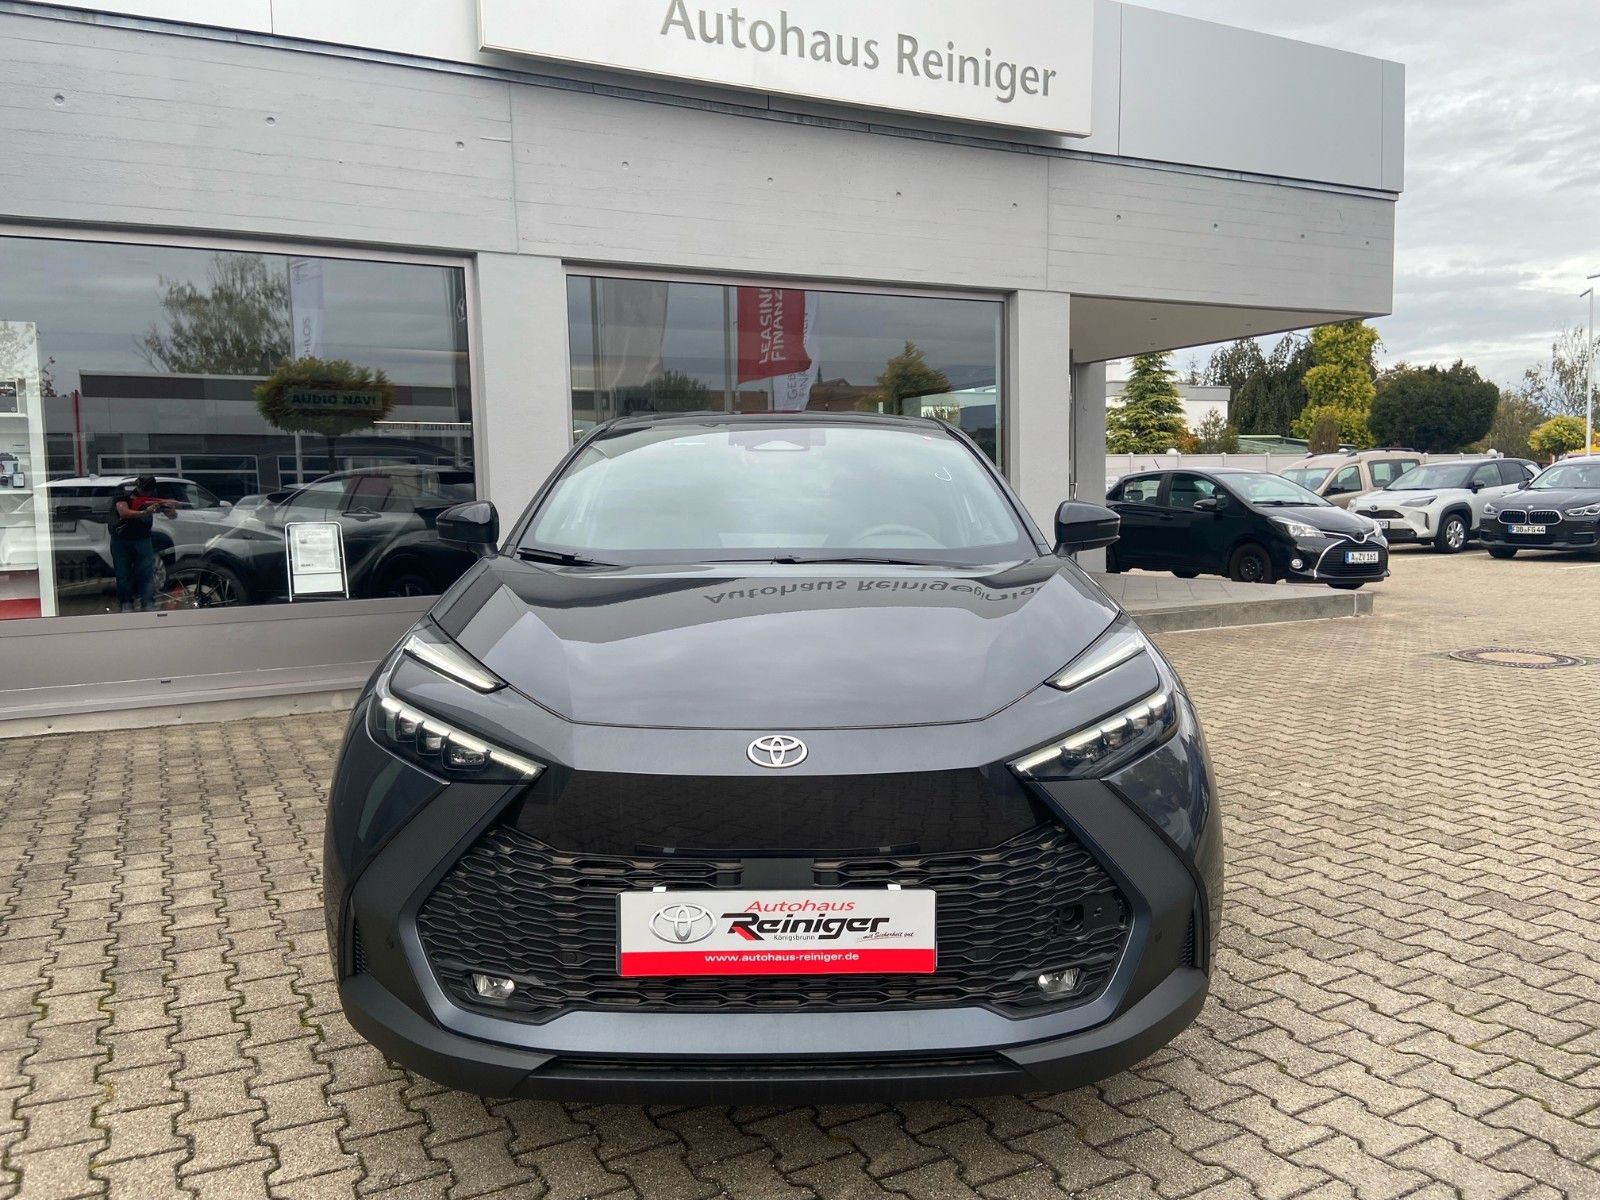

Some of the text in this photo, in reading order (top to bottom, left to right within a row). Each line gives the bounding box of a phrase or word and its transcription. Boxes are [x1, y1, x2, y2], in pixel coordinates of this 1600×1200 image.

[660, 0, 1057, 104] Autohaus Reiniger
[291, 394, 376, 405] AUDIO NAVI
[744, 899, 856, 913] Autohaus
[720, 912, 890, 940] Reiniger
[773, 934, 815, 942] Königsbrunn
[704, 952, 860, 963] www.autohaus-reiniger.de
